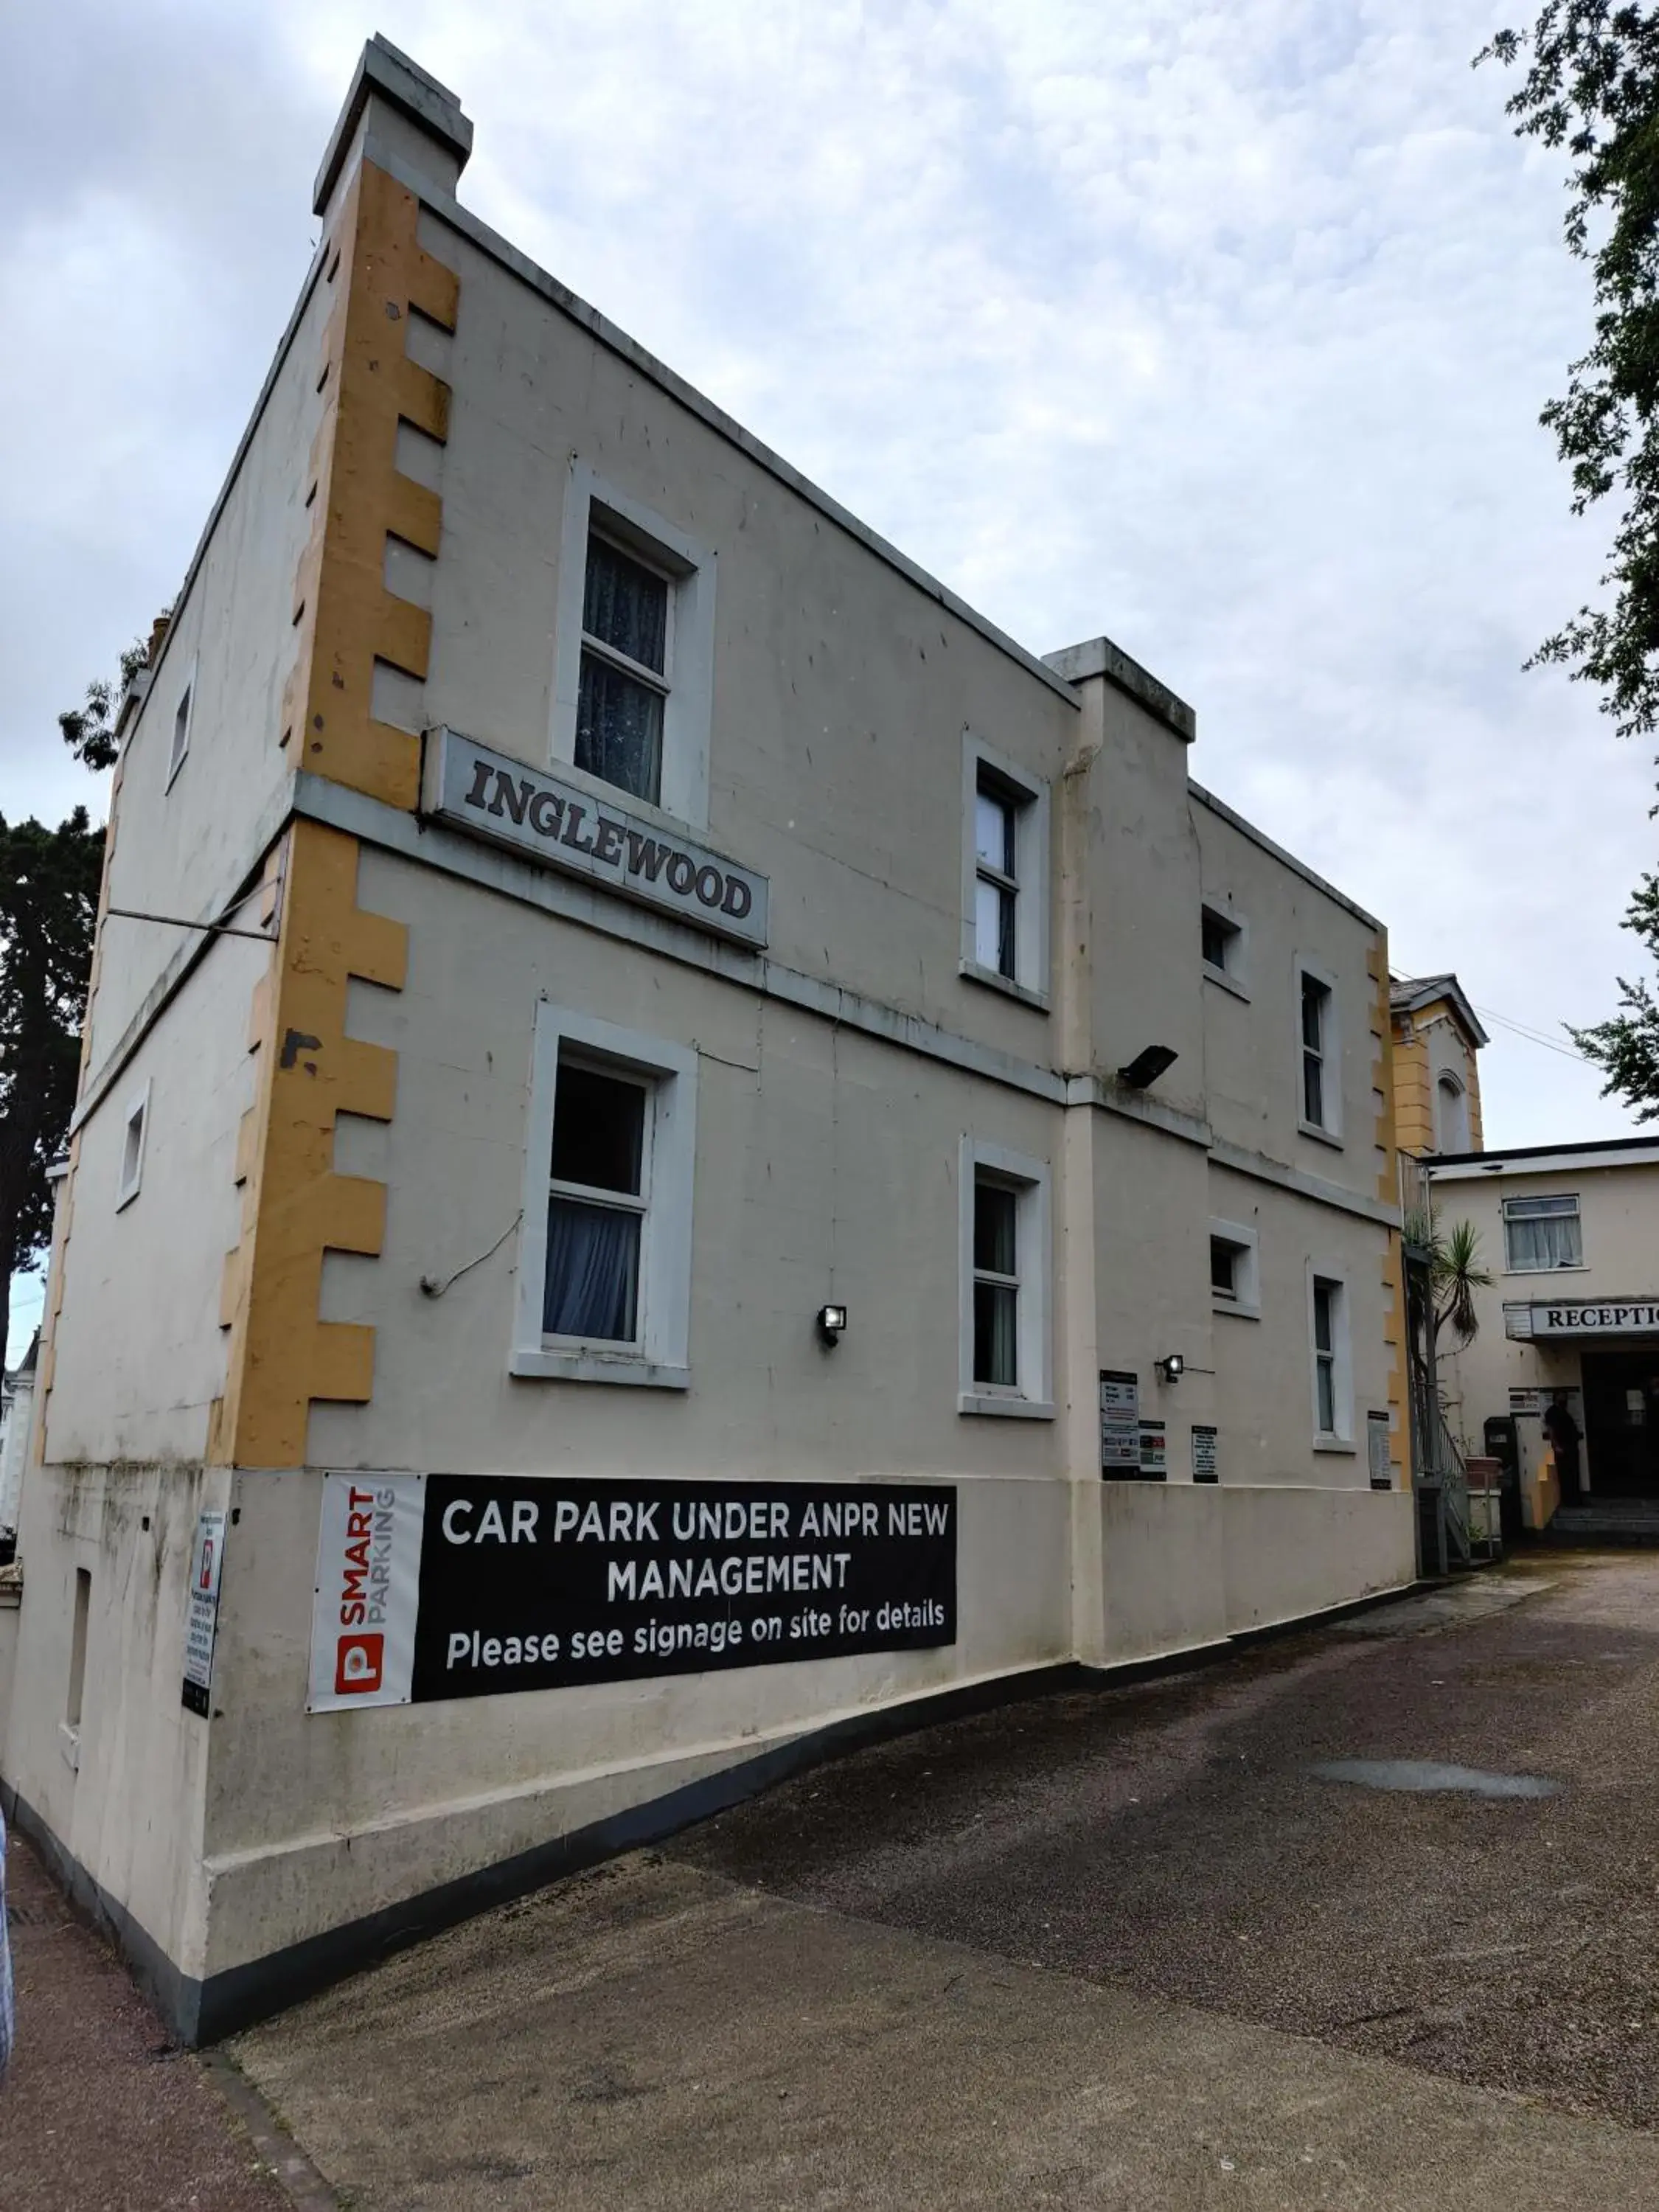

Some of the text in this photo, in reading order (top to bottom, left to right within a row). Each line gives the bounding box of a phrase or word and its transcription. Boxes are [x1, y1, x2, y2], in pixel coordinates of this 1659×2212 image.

[465, 760, 752, 919] INGLEWOOD
[1546, 1307, 1659, 1327] RECEPTI
[442, 1500, 949, 1544] CAR PARK UNDER ANPR NEW
[340, 1486, 373, 1625] SMART
[368, 1487, 396, 1624] PARKING
[608, 1553, 851, 1602] MANAGEMENT
[344, 1646, 377, 1681] P
[446, 1599, 945, 1669] Please see signage on site for details
